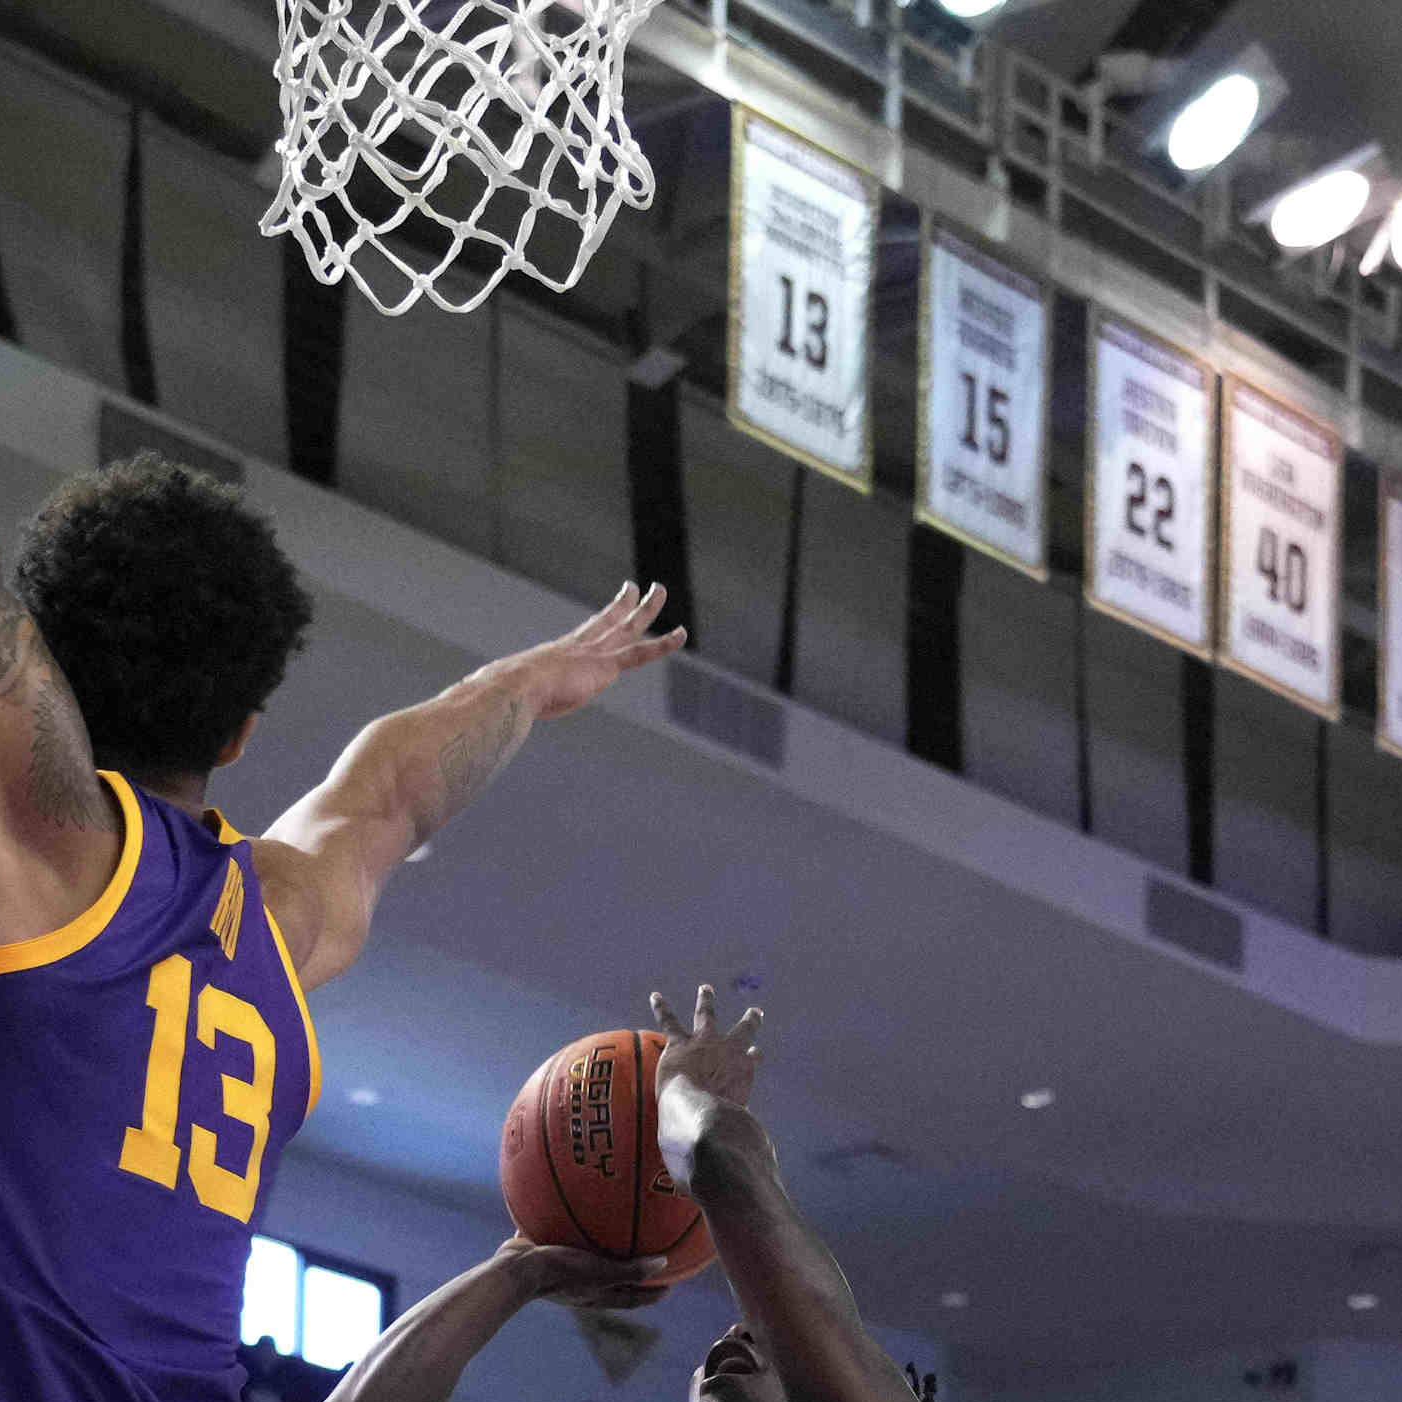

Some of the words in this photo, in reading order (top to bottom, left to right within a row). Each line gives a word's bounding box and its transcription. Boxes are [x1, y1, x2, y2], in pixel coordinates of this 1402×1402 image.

[775, 272, 830, 372] 13
[958, 371, 1011, 466] 15
[1126, 461, 1176, 553] 22
[1256, 526, 1309, 615] 40
[118, 953, 276, 1225] 13
[590, 1044, 617, 1178] LEGACY
